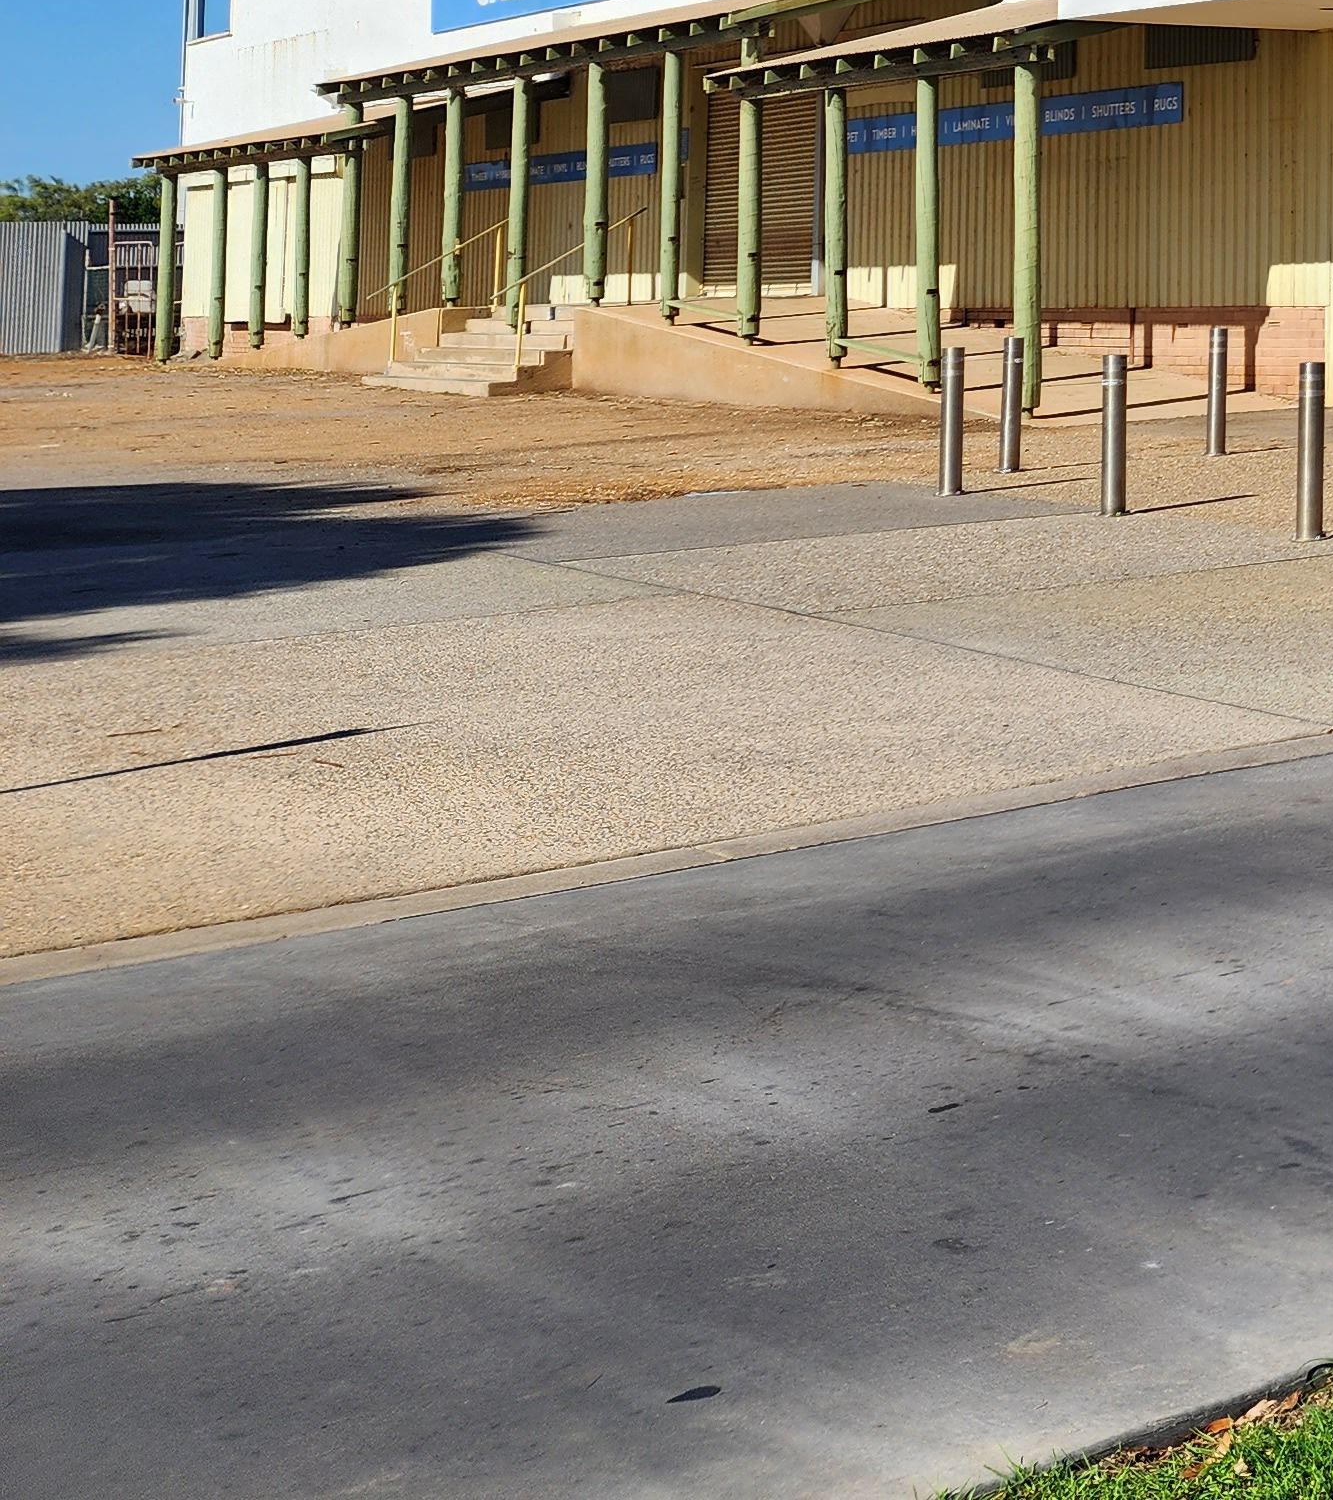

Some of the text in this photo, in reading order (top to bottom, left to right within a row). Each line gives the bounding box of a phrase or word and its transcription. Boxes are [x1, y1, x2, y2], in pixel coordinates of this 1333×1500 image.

[1045, 96, 1179, 123] BLINDS SHUTTERS RUGS
[953, 117, 991, 133] LAMINATE
[872, 127, 897, 141] TIMBER
